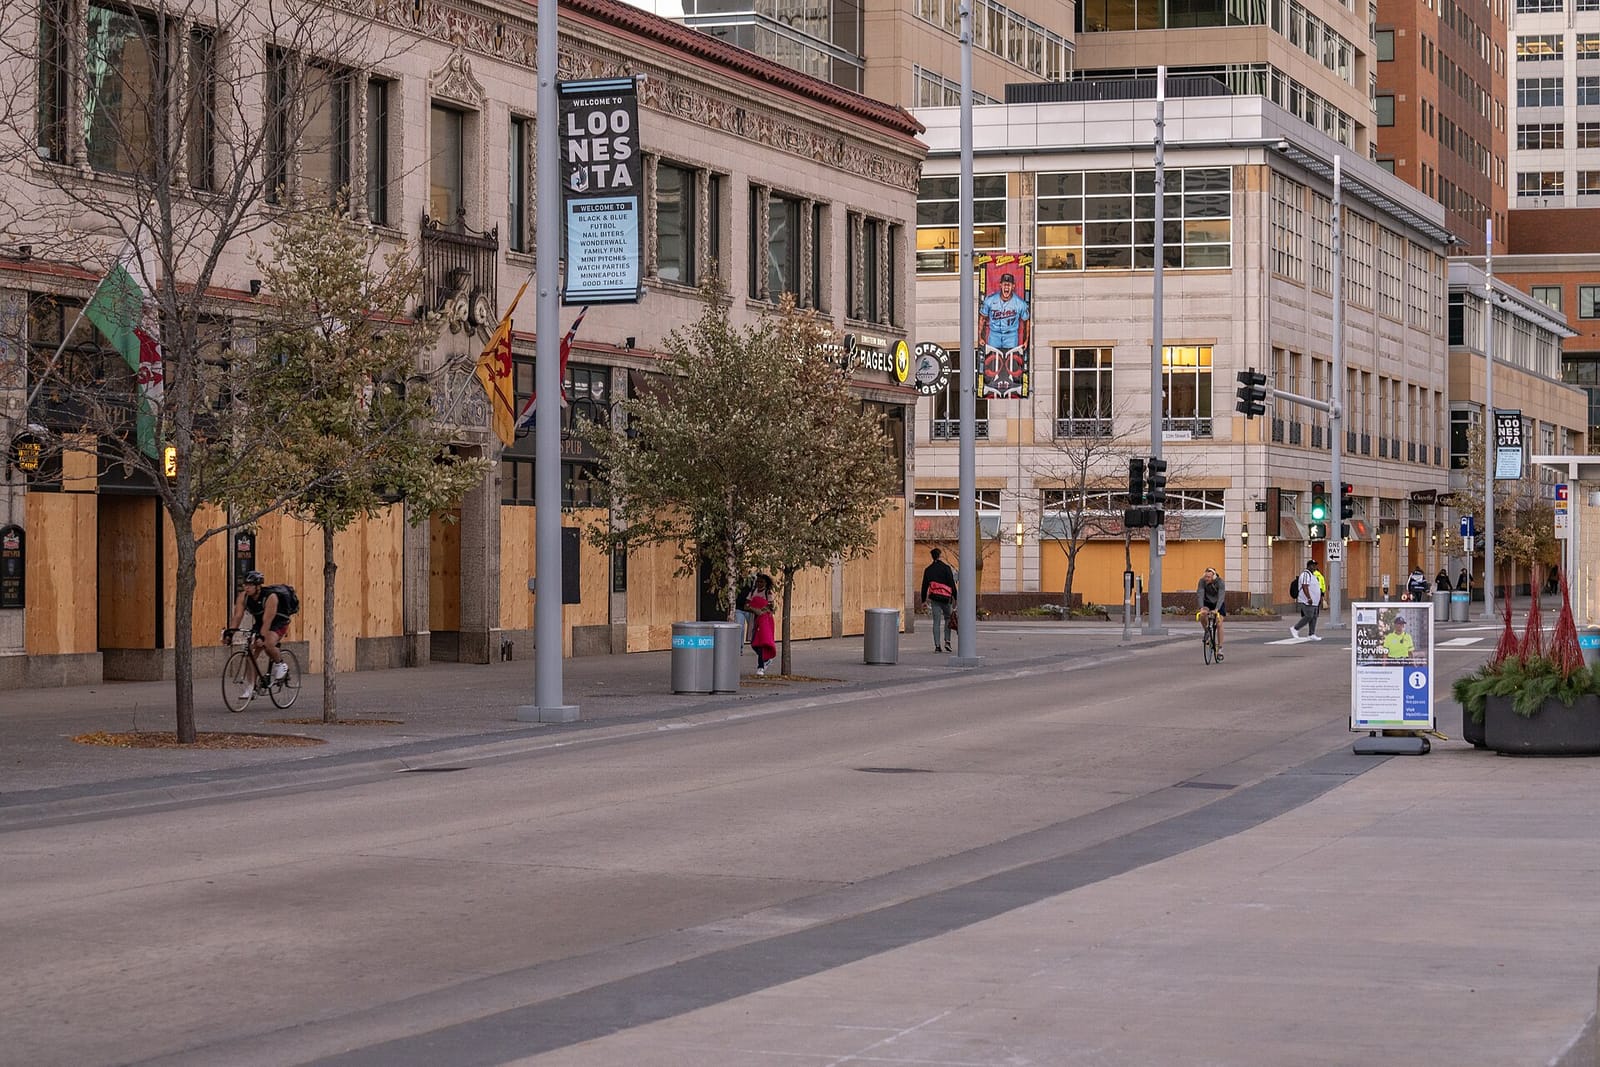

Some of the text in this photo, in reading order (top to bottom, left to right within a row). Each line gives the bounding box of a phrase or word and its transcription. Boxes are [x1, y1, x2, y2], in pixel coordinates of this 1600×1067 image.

[574, 98, 610, 106] WELCOME
[568, 110, 630, 136] LOO
[568, 136, 631, 162] NES
[992, 309, 1016, 319] Twins
[915, 344, 948, 363] OFFEE
[1497, 419, 1520, 427] LOO
[1498, 428, 1520, 436] NES
[566, 440, 582, 454] PUB
